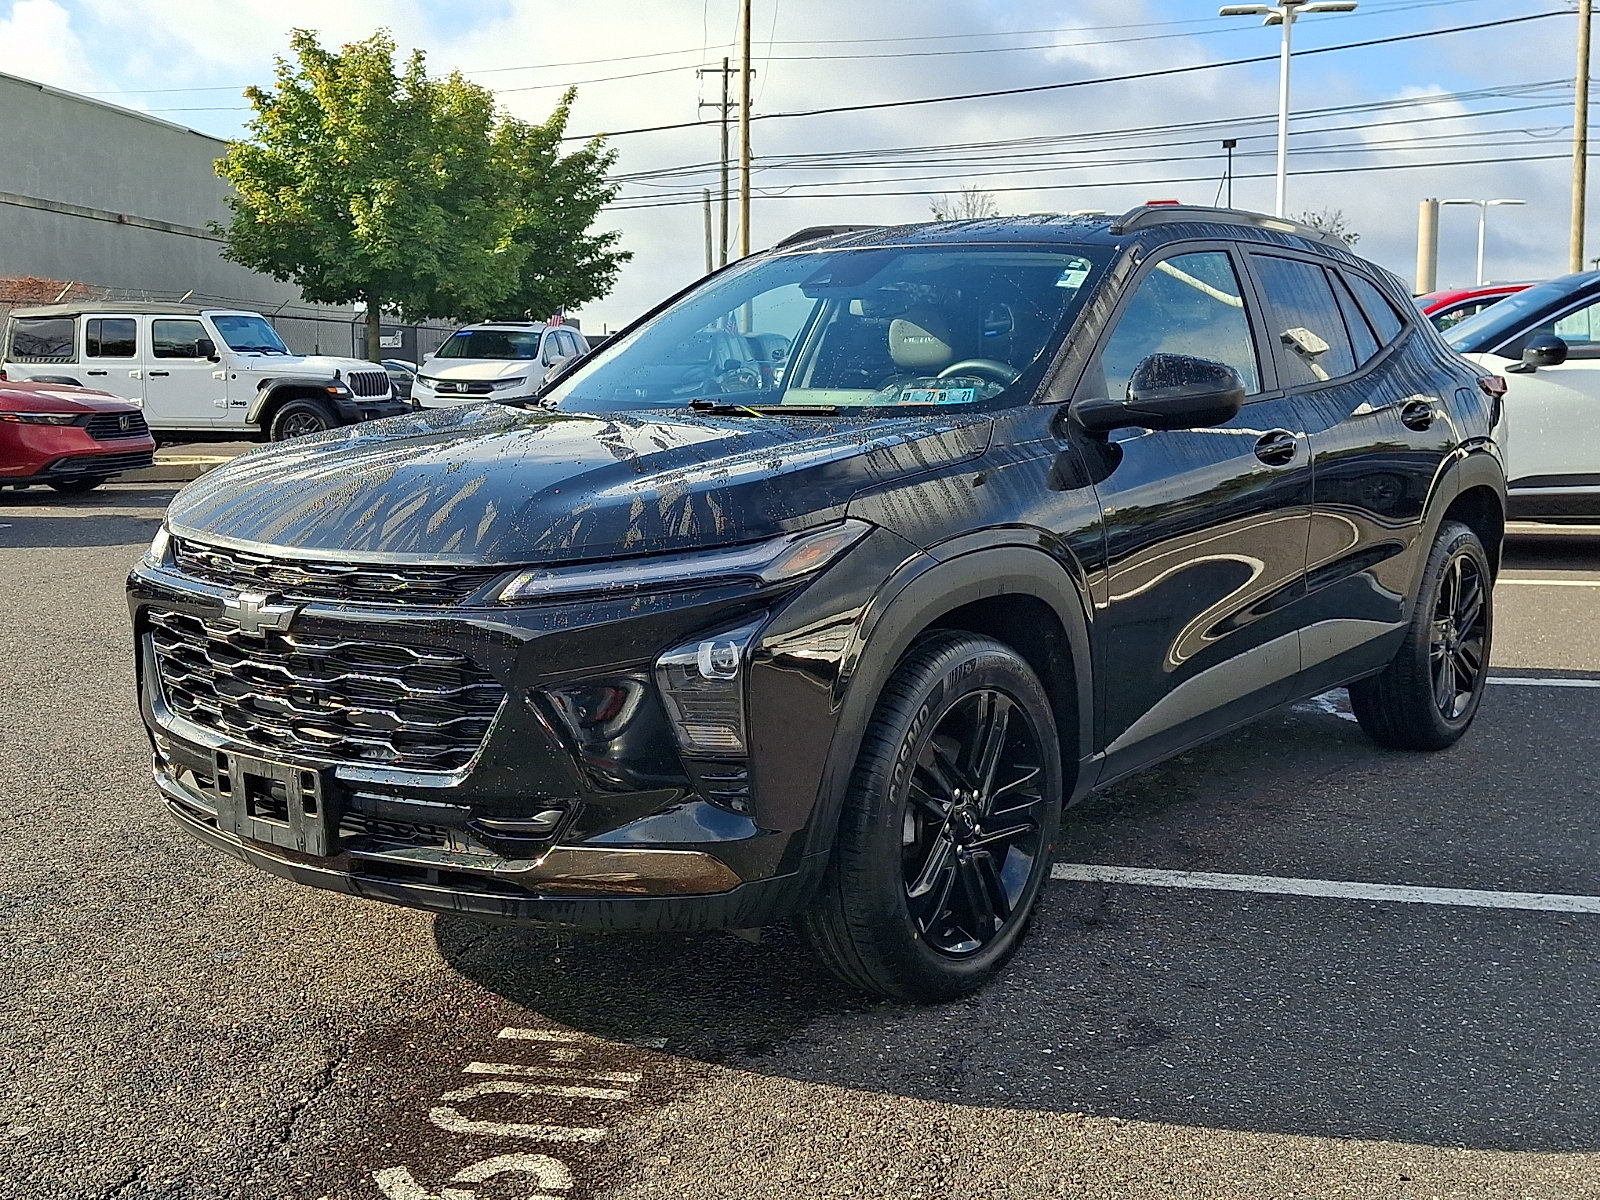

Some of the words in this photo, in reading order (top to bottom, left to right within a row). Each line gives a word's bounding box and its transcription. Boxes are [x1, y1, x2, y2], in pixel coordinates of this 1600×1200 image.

[924, 391, 936, 402] 27
[961, 390, 972, 402] 27
[889, 704, 929, 805] COSMO
